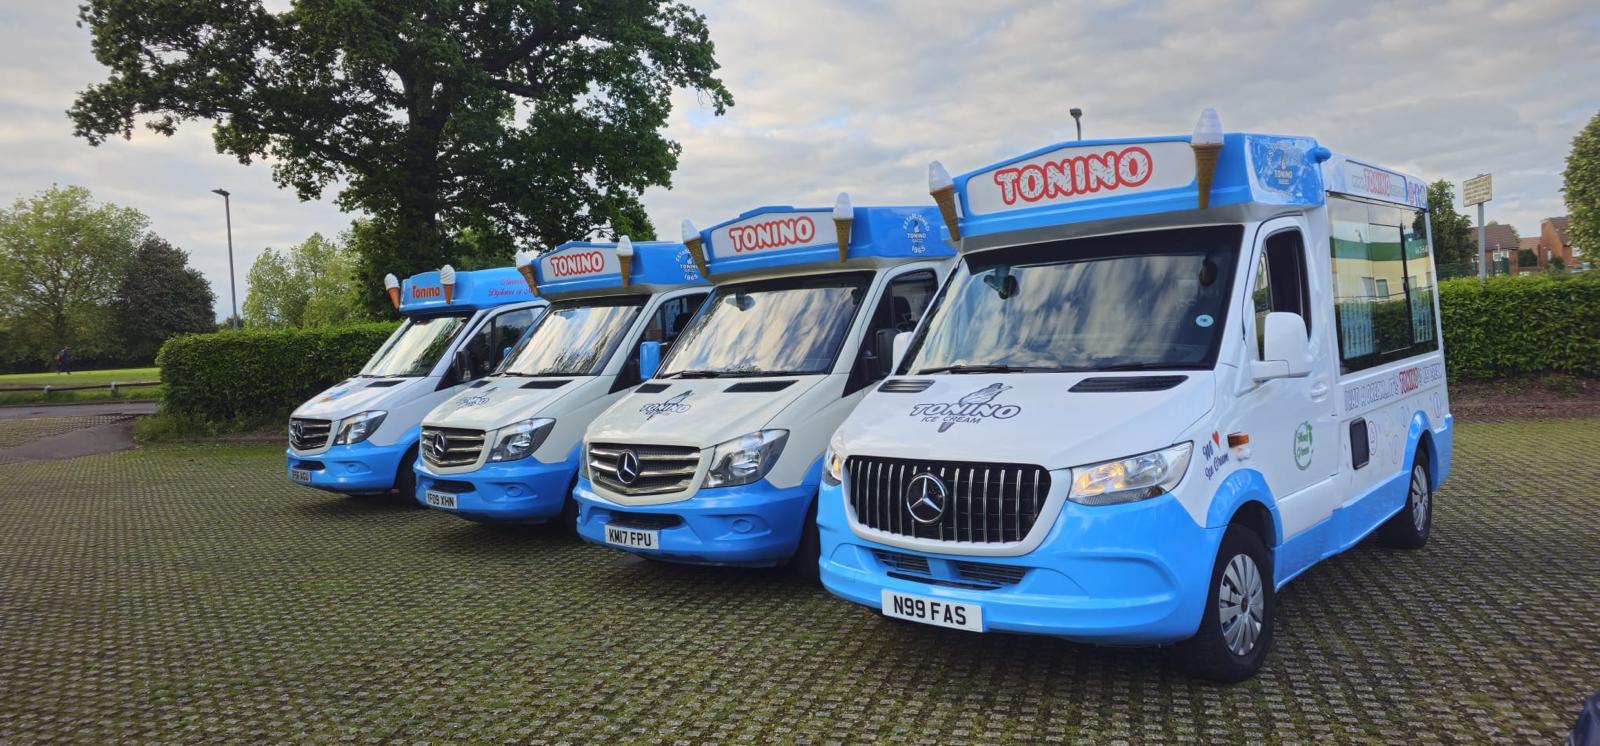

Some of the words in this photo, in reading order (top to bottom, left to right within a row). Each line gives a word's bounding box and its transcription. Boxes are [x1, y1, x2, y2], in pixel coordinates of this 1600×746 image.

[994, 146, 1153, 205] TONINO
[1363, 168, 1393, 197] TONINO
[729, 216, 815, 253] TONINO
[551, 251, 604, 277] TONINO
[411, 285, 440, 299] Tonino
[639, 403, 691, 413] TONINO
[909, 403, 1021, 419] TONINO
[943, 416, 981, 424] CREAM
[440, 495, 454, 507] XHN
[608, 528, 627, 544] KM17
[630, 531, 652, 547] FPU
[893, 595, 926, 619] N99
[930, 601, 967, 626] FAS
